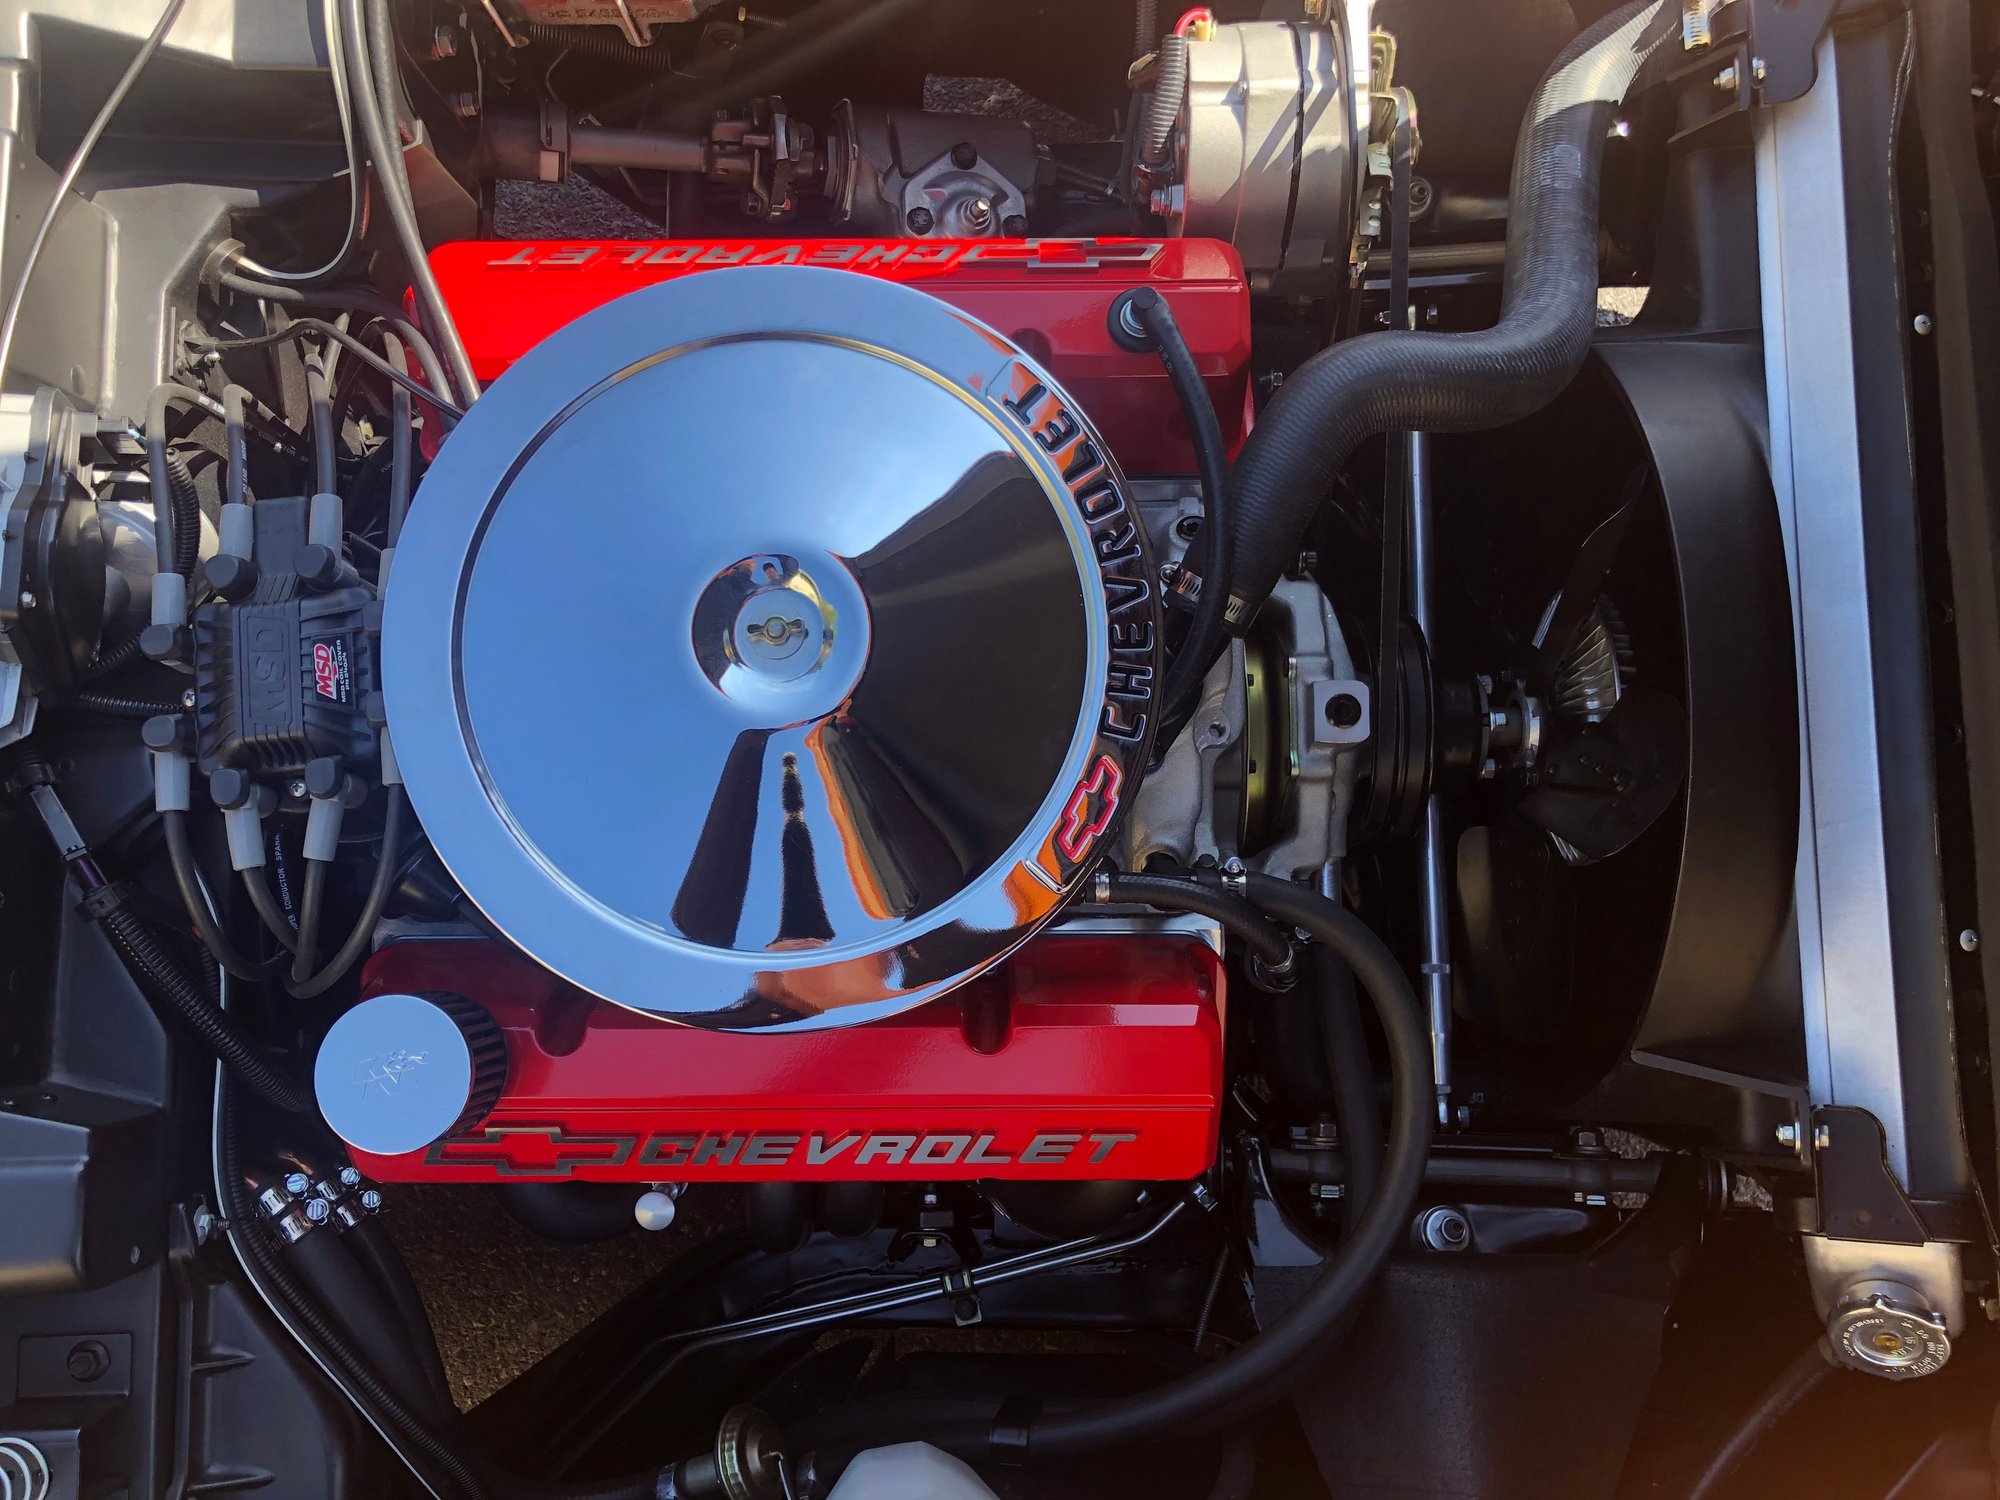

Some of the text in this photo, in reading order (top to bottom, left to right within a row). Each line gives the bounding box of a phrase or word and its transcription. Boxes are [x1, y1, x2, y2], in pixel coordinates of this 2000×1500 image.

[485, 245, 960, 267] CHEVROLET
[1003, 383, 1154, 742] CHEVROLET
[314, 644, 337, 700] MSD
[344, 678, 350, 690] PN
[278, 868, 292, 910] CONDUCTOR
[638, 1132, 1137, 1166] CHEVROLET
